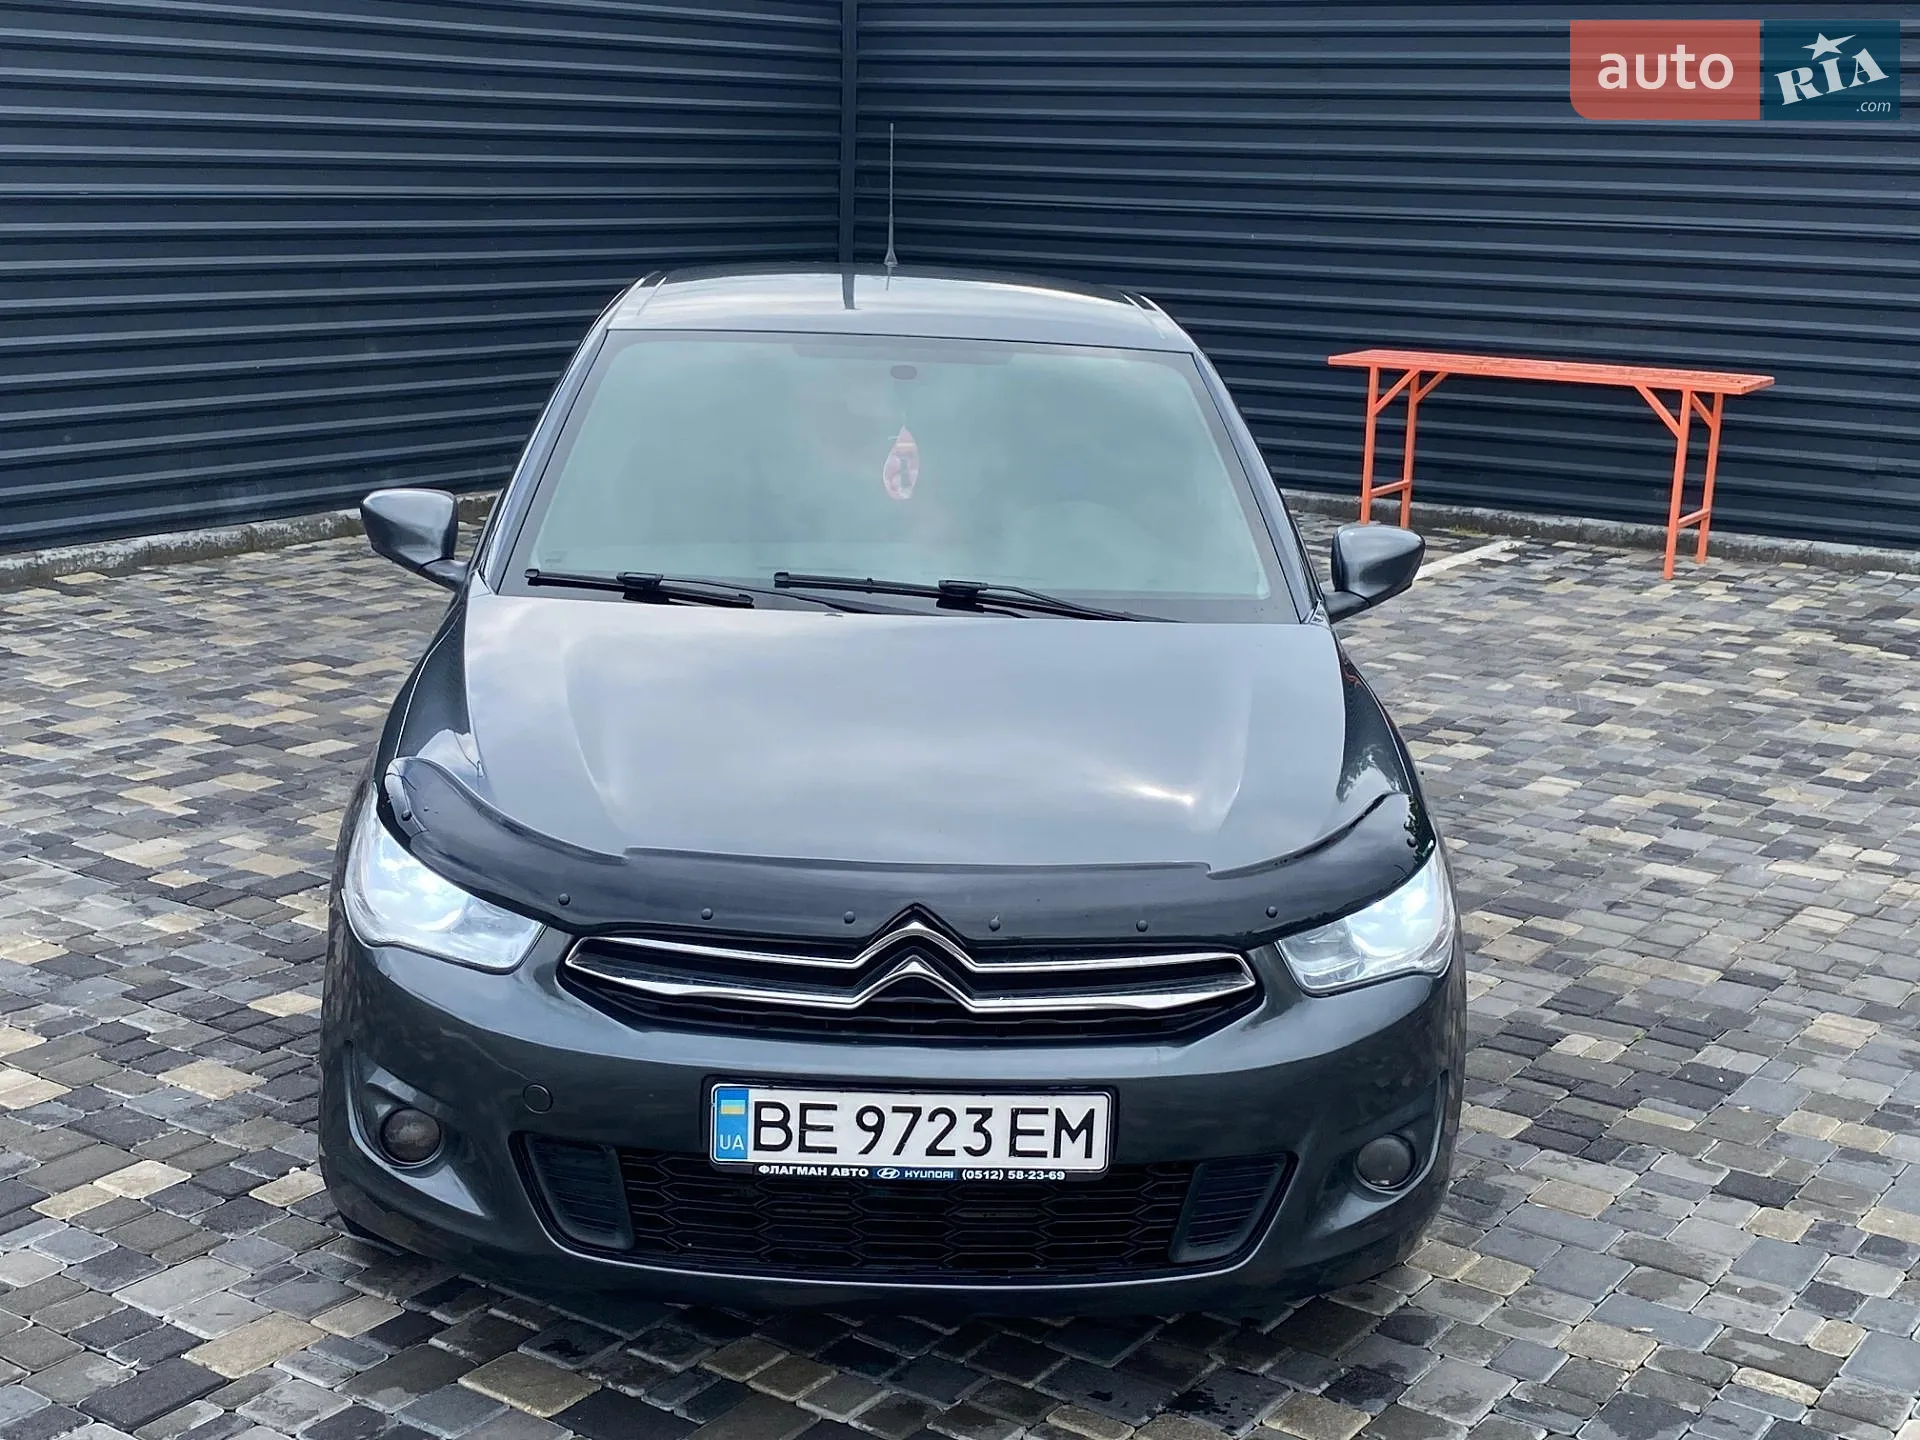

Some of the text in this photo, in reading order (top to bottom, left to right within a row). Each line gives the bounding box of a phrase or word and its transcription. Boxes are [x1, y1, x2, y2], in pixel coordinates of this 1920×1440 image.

[752, 1100, 1095, 1159] BE 9723 EM
[720, 1135, 745, 1151] UA
[758, 1165, 1065, 1180] ФЛАГМАН АВТО HYUNDAI (0512) 58-23-69
